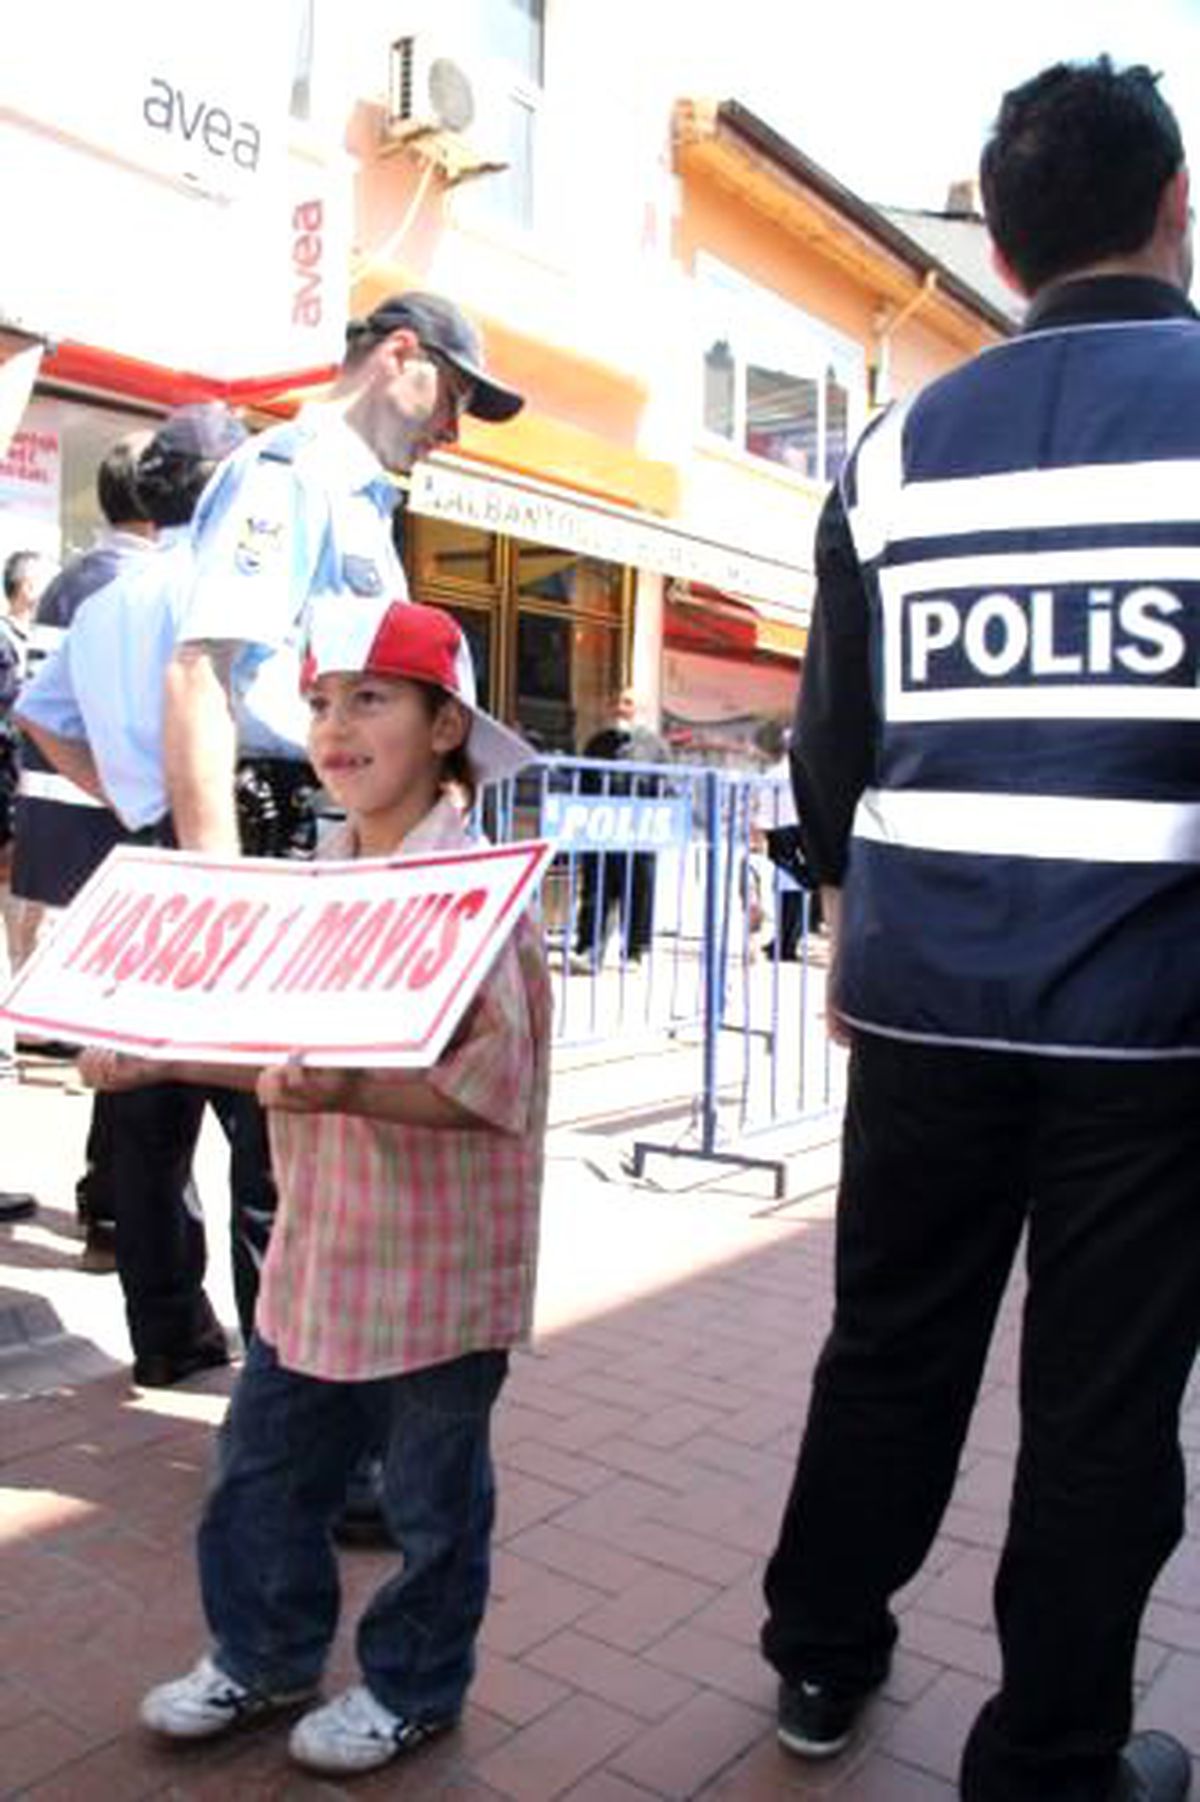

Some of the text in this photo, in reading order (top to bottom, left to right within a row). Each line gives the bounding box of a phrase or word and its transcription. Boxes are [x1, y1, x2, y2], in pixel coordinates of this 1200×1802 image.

[143, 78, 261, 170] avea
[291, 199, 324, 327] avea
[269, 889, 487, 992] MAYIS
